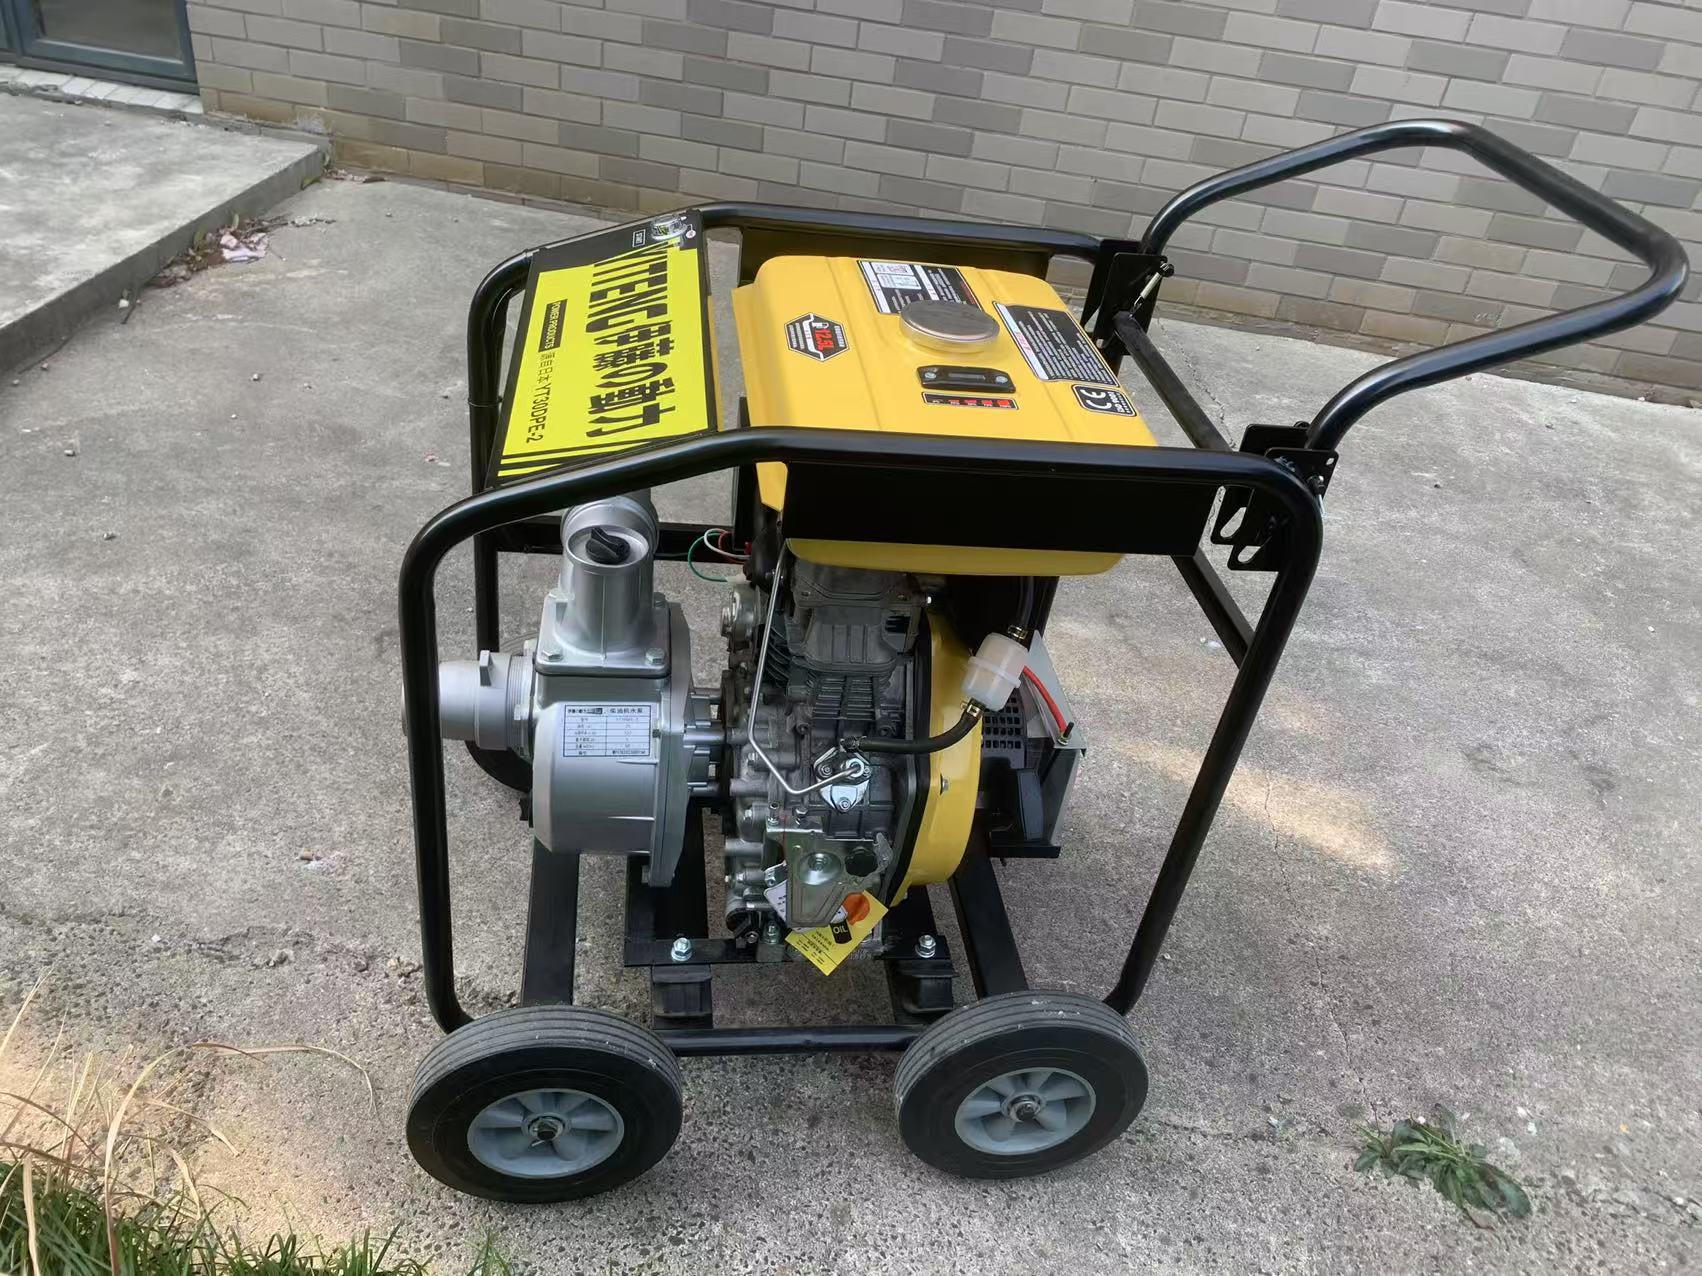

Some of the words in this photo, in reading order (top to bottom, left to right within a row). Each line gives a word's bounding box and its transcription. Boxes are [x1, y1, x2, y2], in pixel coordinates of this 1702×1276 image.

[585, 242, 668, 333] YITENG
[549, 302, 561, 321] POWER
[544, 321, 558, 349] PRODUCTS
[1080, 389, 1112, 409] CE
[526, 383, 551, 443] YT30DPE-2
[833, 925, 848, 934] OIL
